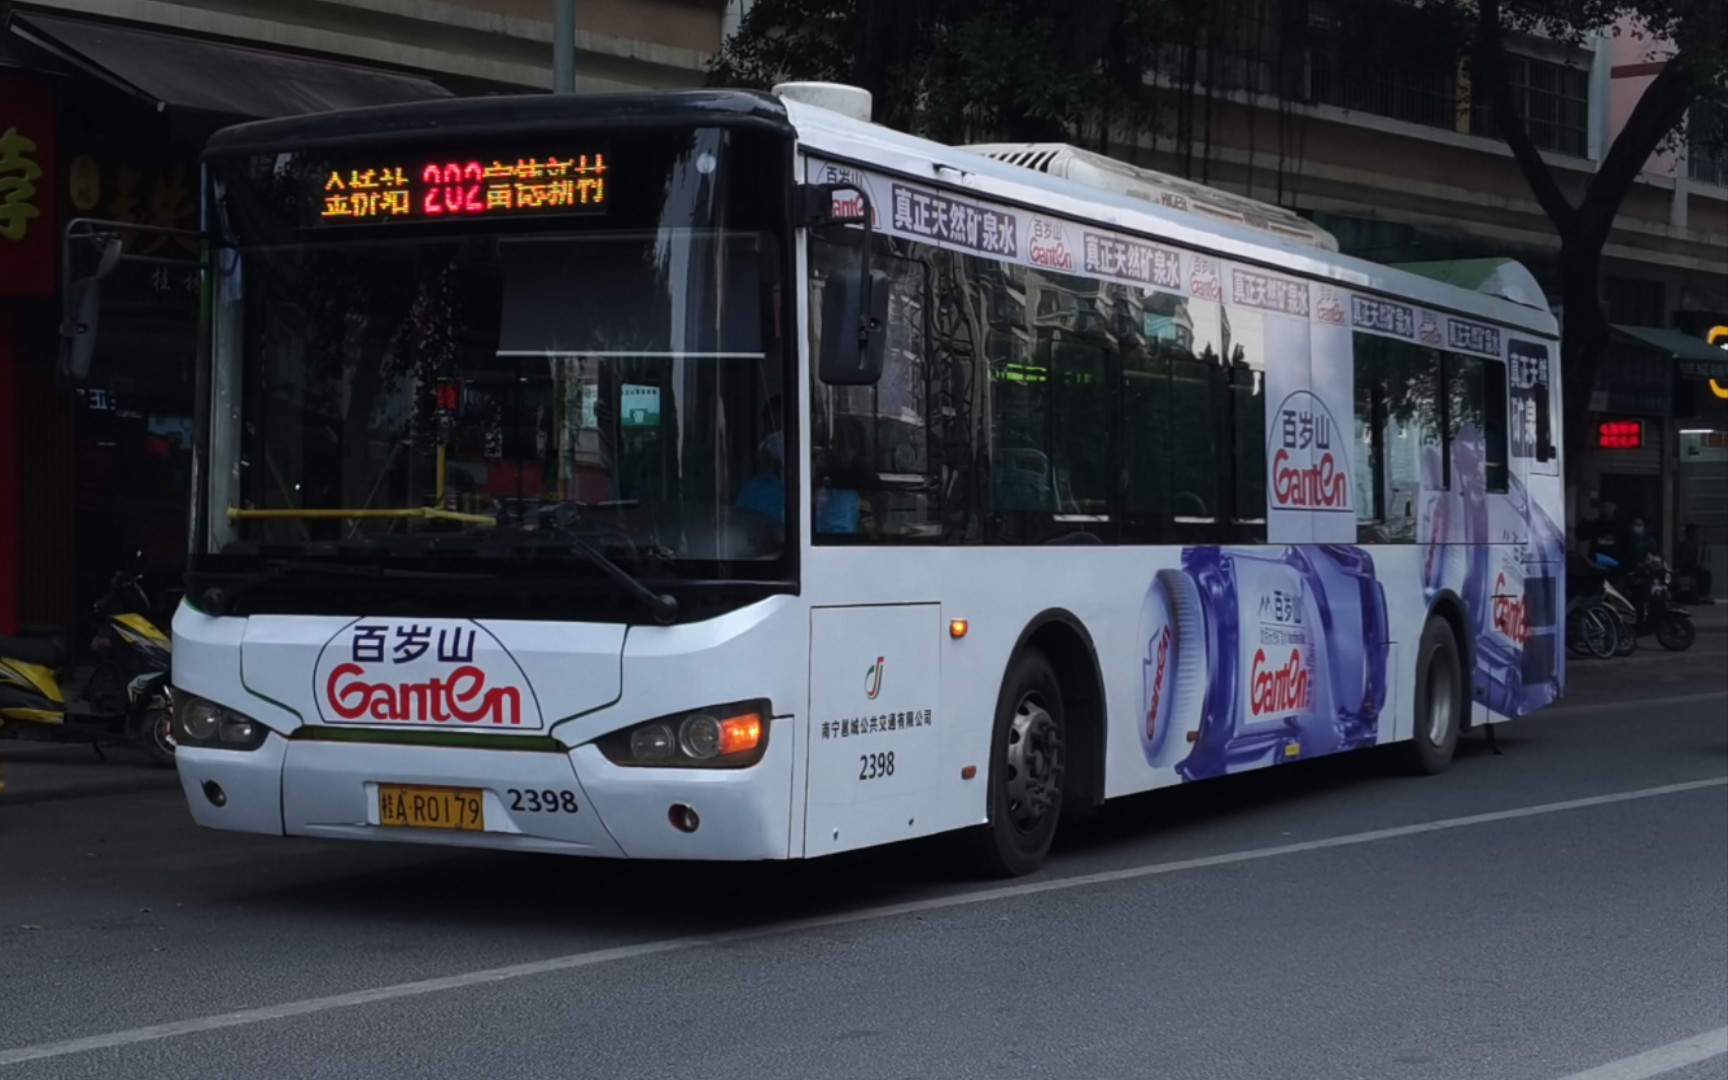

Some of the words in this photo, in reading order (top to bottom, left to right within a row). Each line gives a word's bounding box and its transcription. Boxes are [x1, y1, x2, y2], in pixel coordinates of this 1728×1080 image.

[421, 161, 485, 213] 202
[895, 187, 1015, 255] 真正天然矿泉水
[1030, 236, 1072, 269] Ganten
[1086, 236, 1179, 286] 真正天然矿泉水
[1234, 272, 1309, 315] 真正天然矿泉水
[1282, 410, 1330, 450] 百岁山
[1511, 397, 1537, 445] 矿泉
[1273, 448, 1347, 507] Ganten
[352, 624, 476, 664] 百岁山
[327, 662, 521, 725] Ganten
[1251, 648, 1307, 716] Ganten
[821, 709, 932, 740] 南宁邕城公共交通有限公司
[859, 751, 895, 781] 2398
[507, 789, 579, 814] 2398
